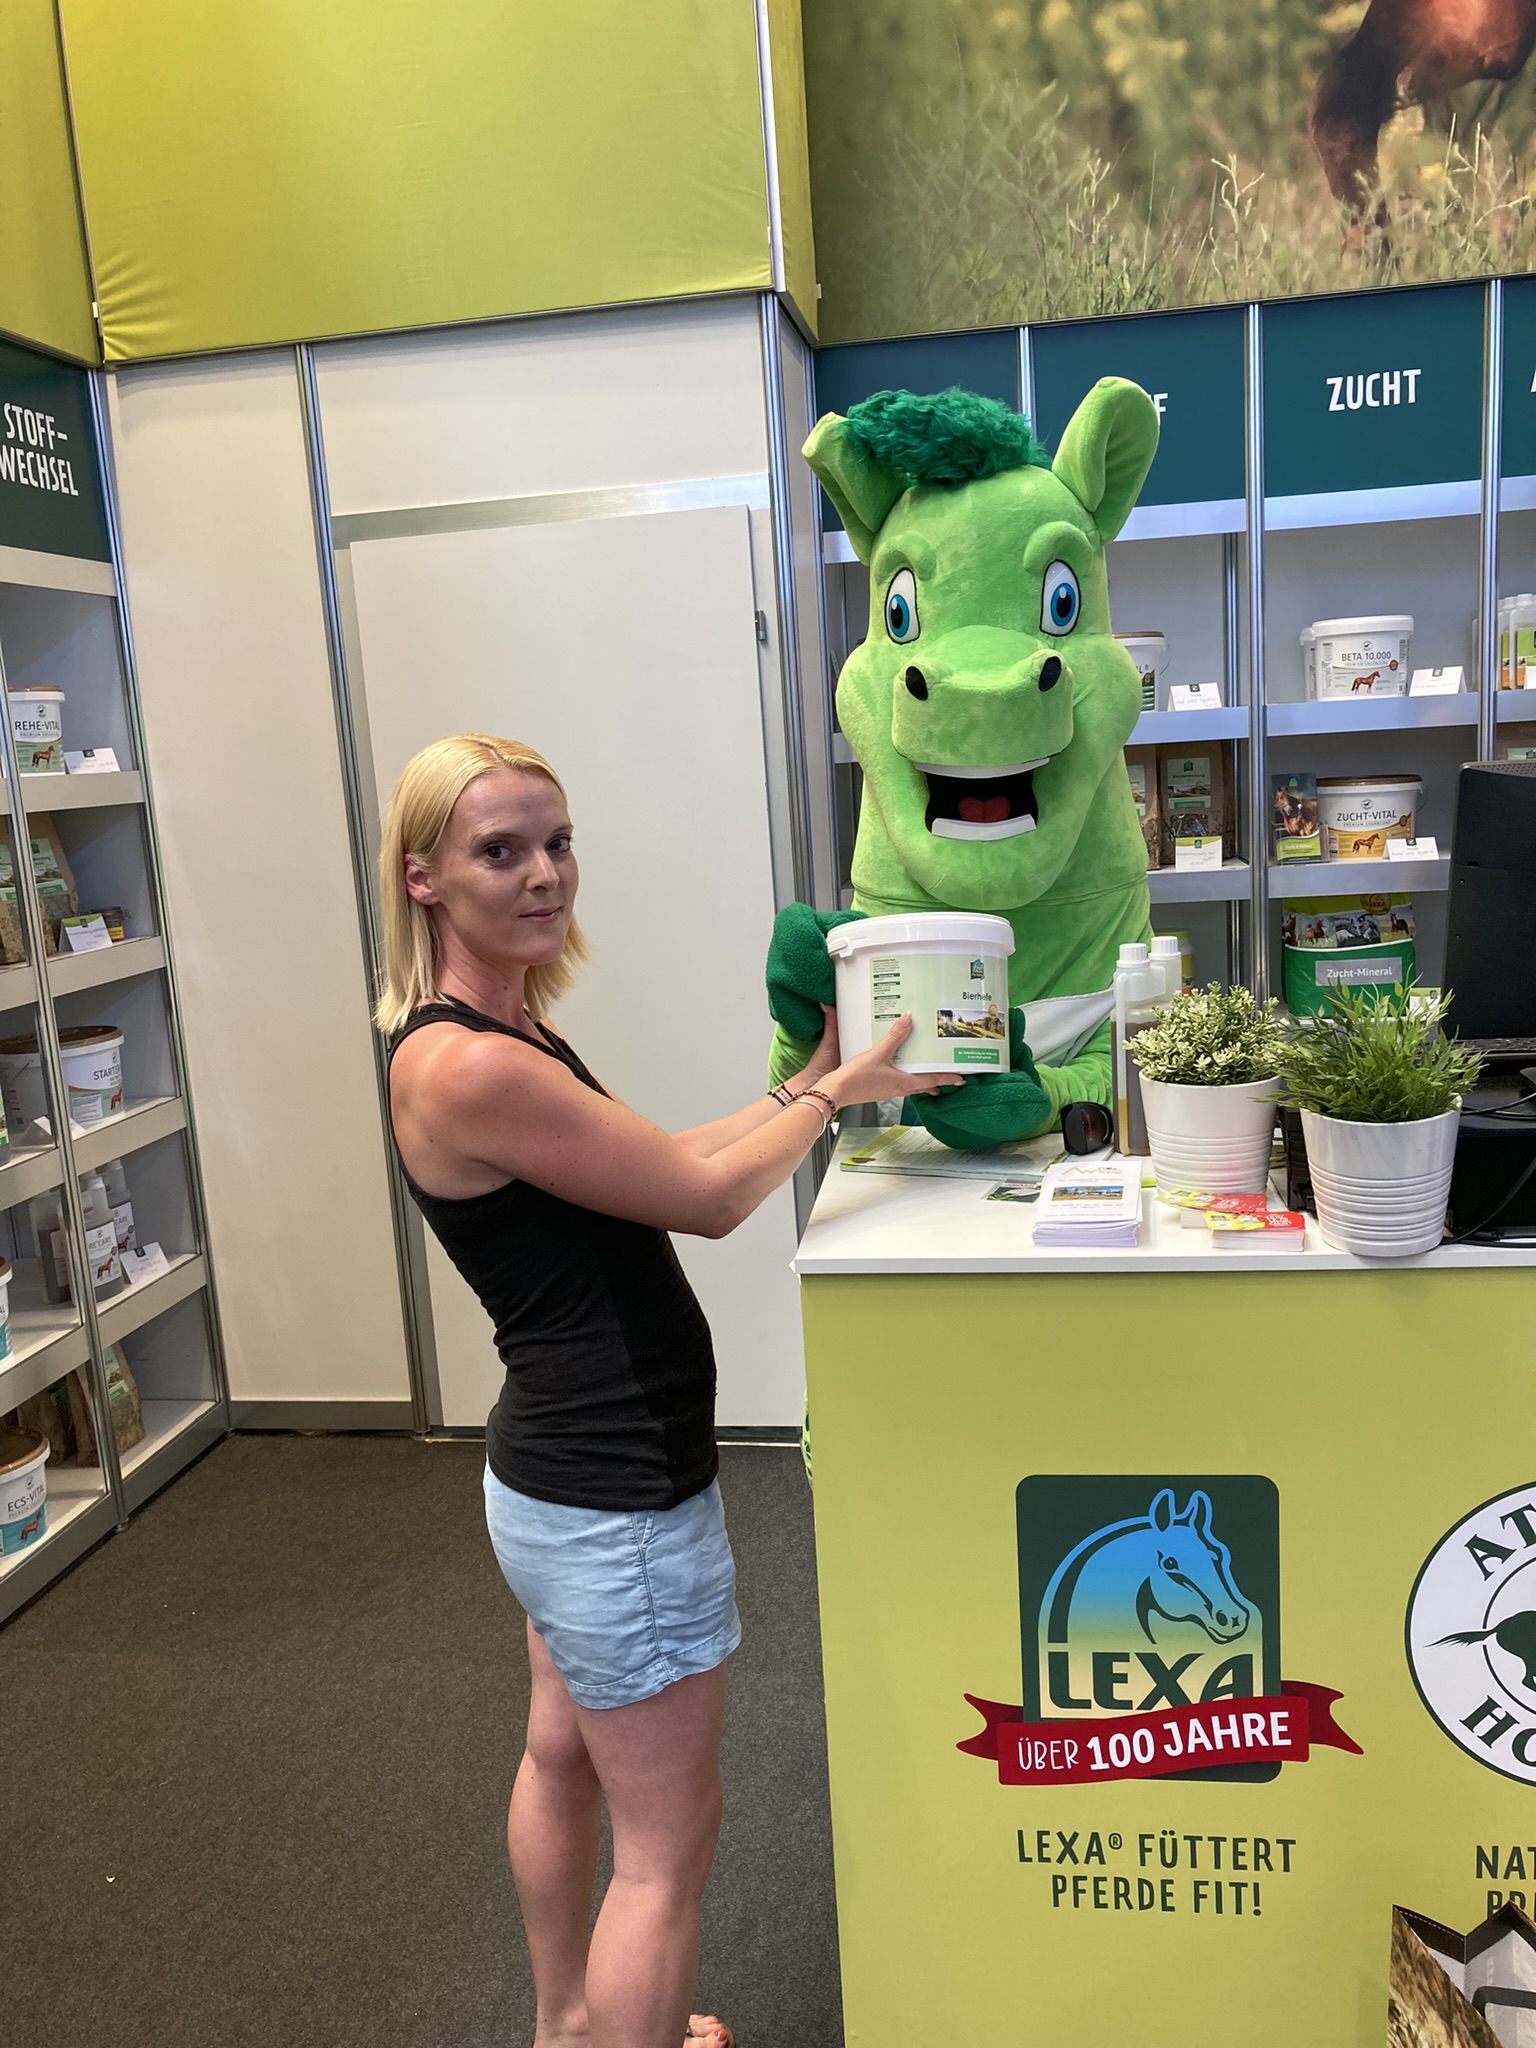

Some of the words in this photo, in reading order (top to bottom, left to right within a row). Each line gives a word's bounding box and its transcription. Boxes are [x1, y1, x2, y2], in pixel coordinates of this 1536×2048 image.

[1326, 368, 1422, 412] ZUCHT
[3, 402, 68, 450] STOFF-
[0, 444, 79, 497] WECHSEL
[1341, 652, 1363, 662] BETA
[1365, 651, 1392, 661] 10.000
[1336, 810, 1397, 822] ZUCHT-VITAL
[1326, 967, 1393, 978] Zucht-Mineral
[1047, 1651, 1253, 1711] LEXA
[1017, 1736, 1080, 1771] ÜBER
[1086, 1727, 1155, 1771] 100
[1163, 1711, 1293, 1758] JAHRE
[1138, 1829, 1297, 1874] FÜTTERT
[1052, 1874, 1176, 1913] PFERDE
[1193, 1879, 1263, 1917] FIT!
